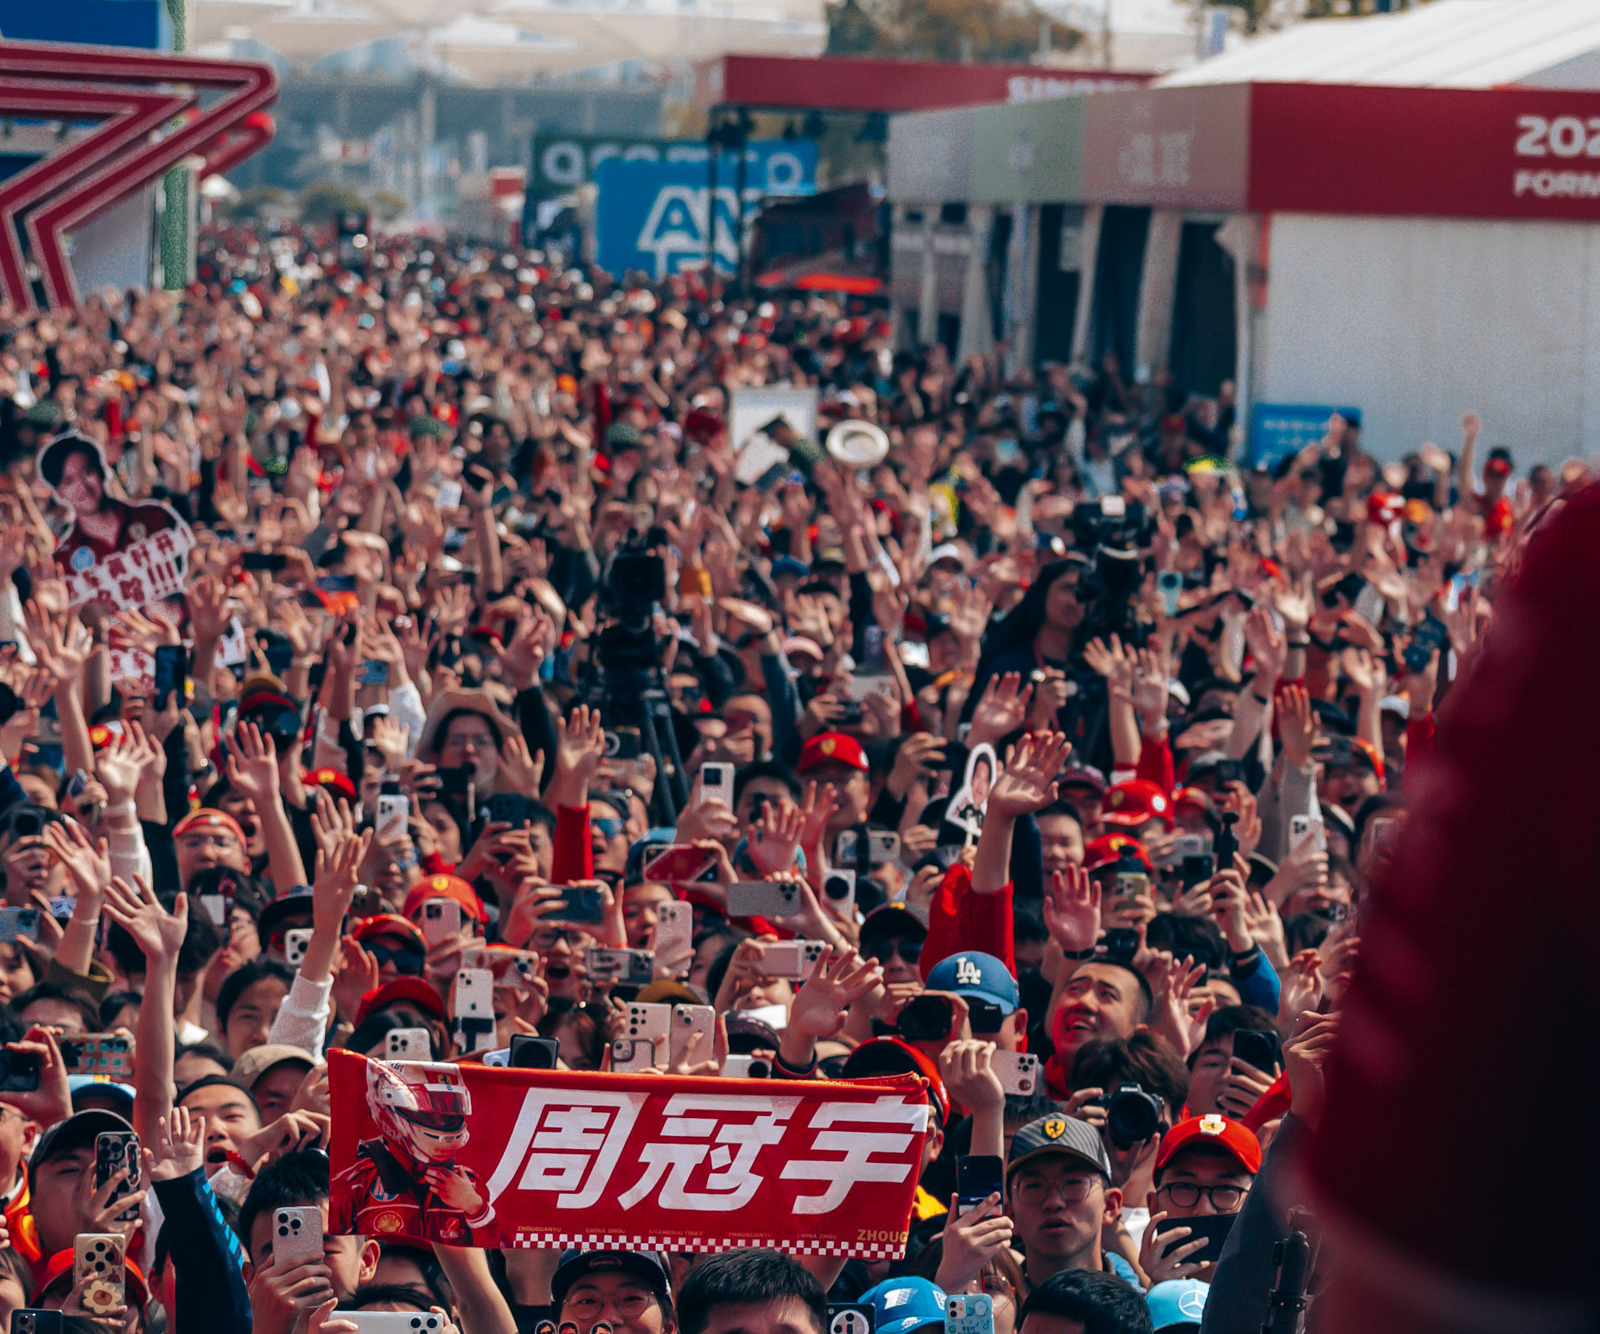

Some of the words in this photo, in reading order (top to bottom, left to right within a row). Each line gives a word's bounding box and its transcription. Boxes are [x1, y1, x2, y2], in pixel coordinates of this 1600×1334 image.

[956, 957, 981, 984] LA
[486, 1087, 929, 1215] 周冠宇
